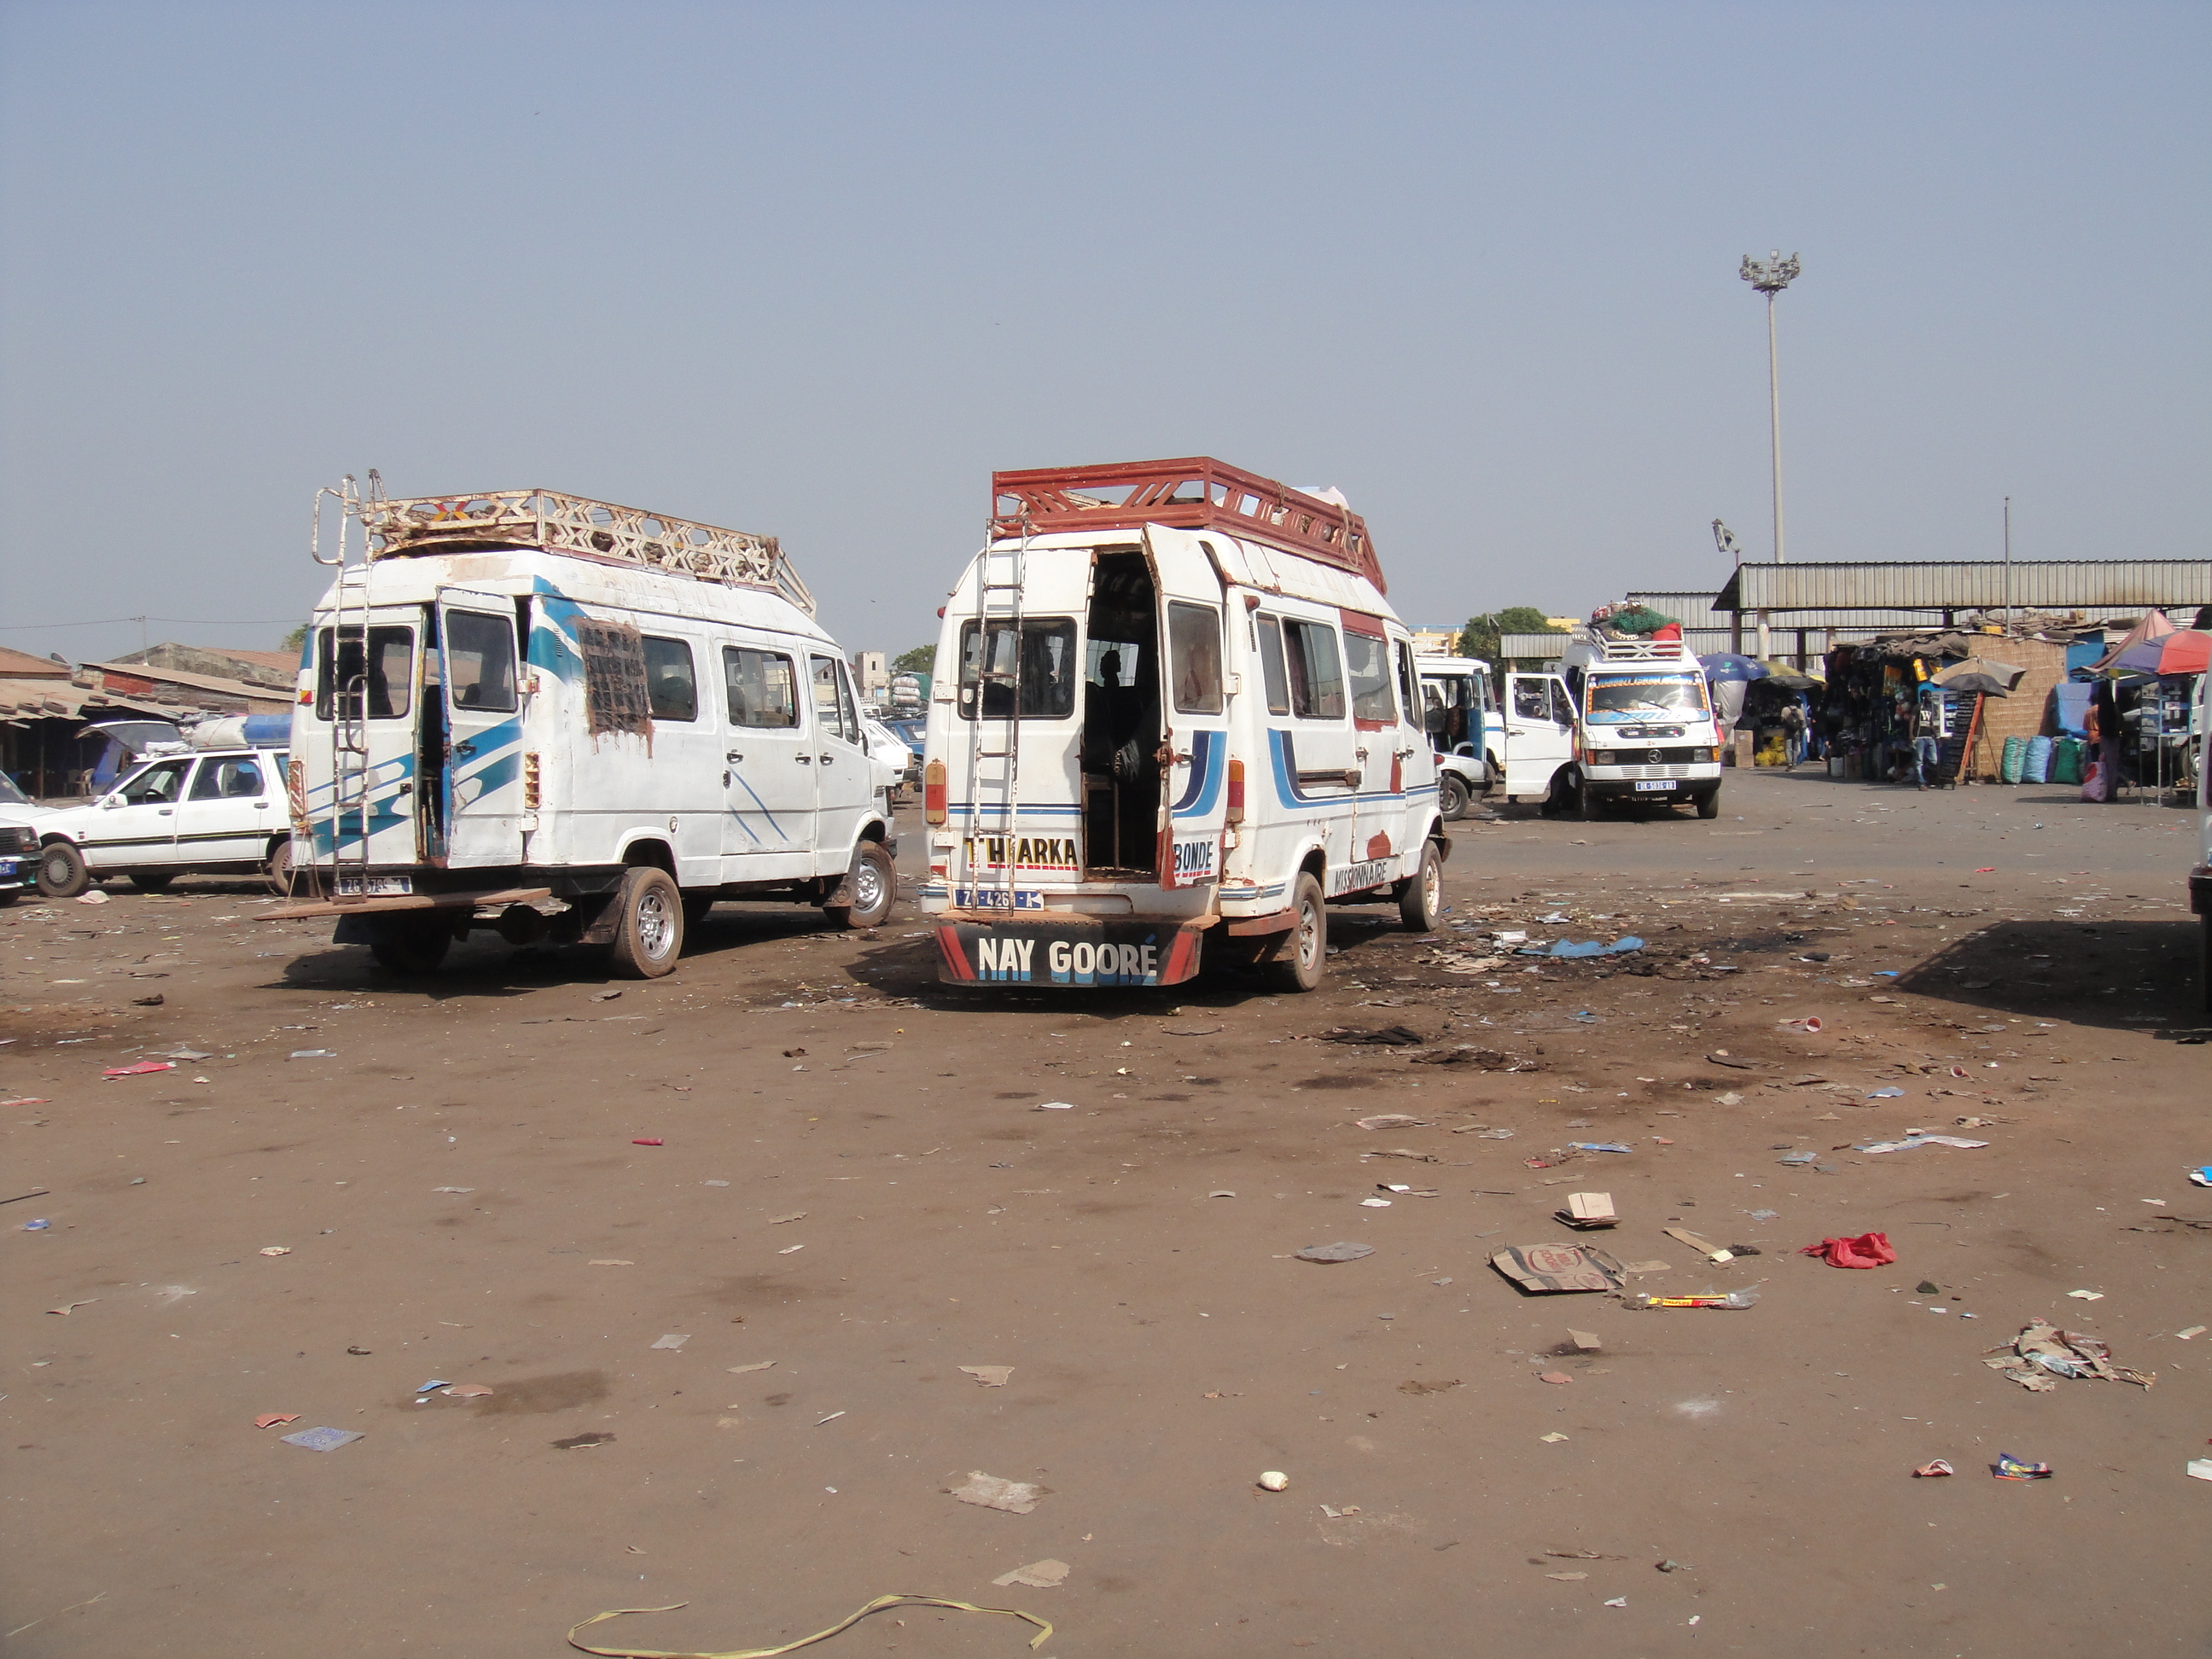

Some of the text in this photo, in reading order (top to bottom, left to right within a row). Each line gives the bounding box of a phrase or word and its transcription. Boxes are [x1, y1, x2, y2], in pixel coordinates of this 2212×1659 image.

[1335, 862, 1387, 893] MISSIONNAIRE
[978, 934, 1157, 984] NAY GOORÉ
